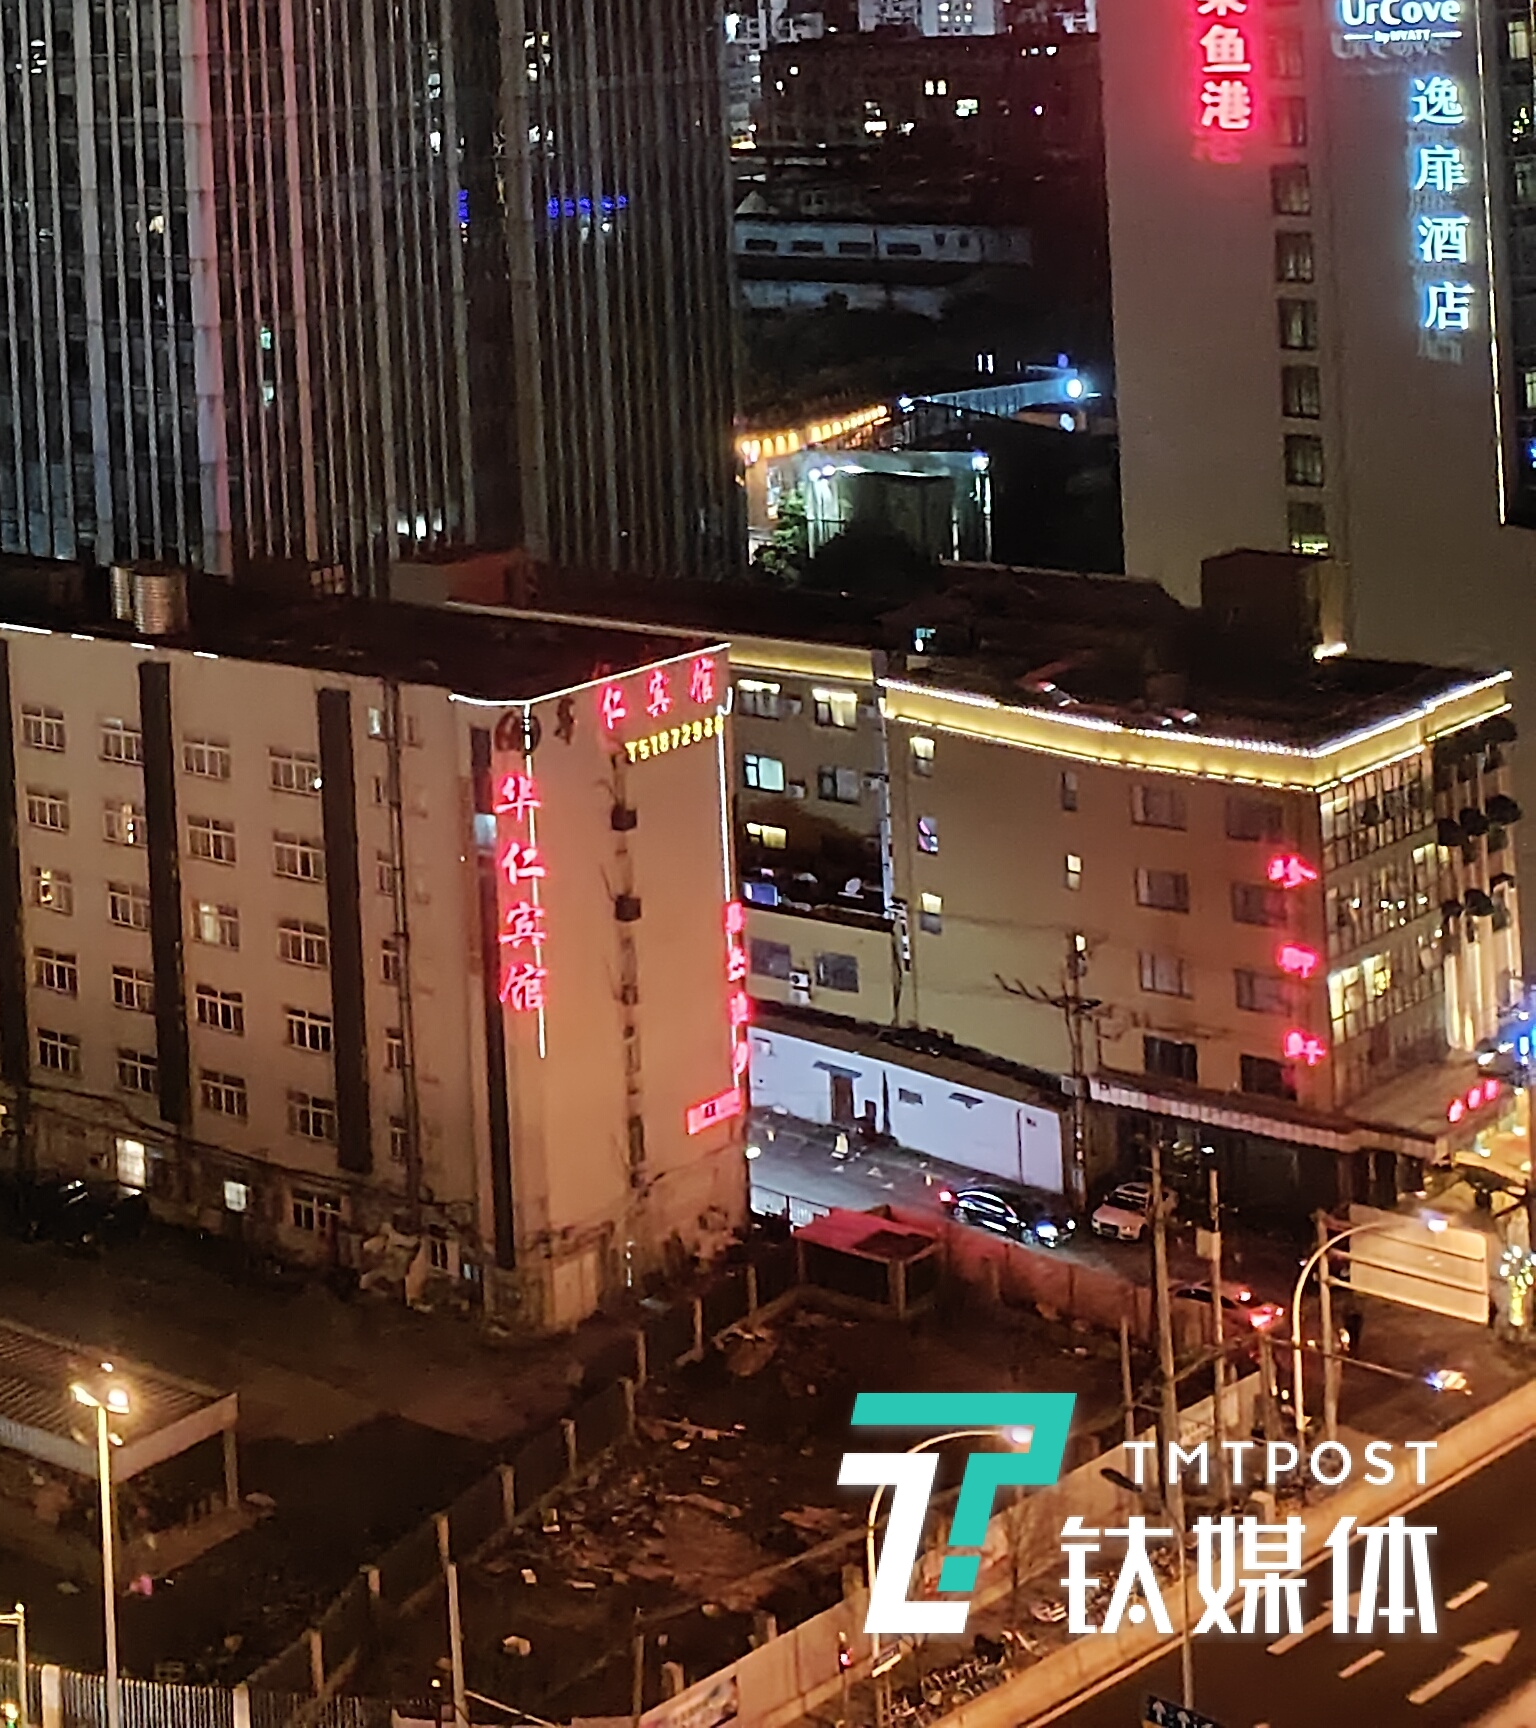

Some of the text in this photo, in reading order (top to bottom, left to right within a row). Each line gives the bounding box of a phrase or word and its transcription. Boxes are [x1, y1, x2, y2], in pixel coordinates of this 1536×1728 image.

[1411, 76, 1475, 330] 逸扉酒店
[494, 776, 547, 1011] 华仁宾馆
